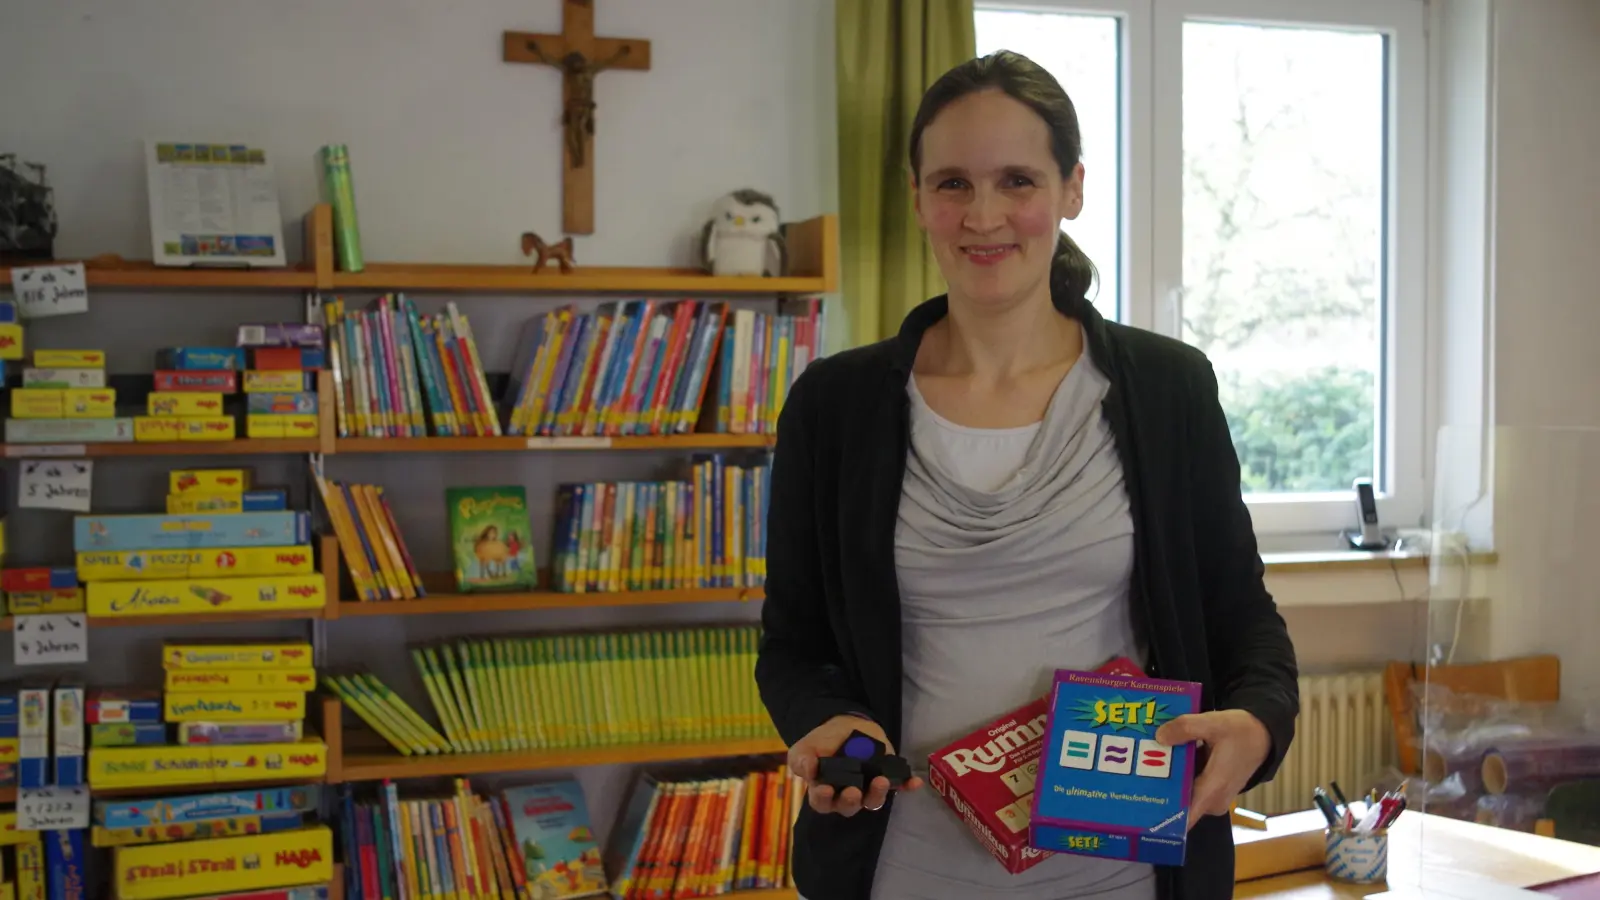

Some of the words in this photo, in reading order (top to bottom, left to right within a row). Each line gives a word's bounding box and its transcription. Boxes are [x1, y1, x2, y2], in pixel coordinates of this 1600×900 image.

[28, 483, 38, 497] 5
[45, 483, 89, 499] Jahren
[39, 621, 54, 632] ab
[36, 640, 80, 655] Jahren
[1069, 673, 1127, 688] Ravensburger
[1130, 680, 1185, 693] Kartenspiele
[1094, 700, 1156, 725] SET!
[988, 720, 1017, 737] Original
[1009, 774, 1019, 783] 7
[1054, 784, 1065, 793] Die
[1066, 786, 1107, 800] ultimative
[1149, 810, 1185, 833] Ravensburger
[1068, 835, 1099, 849] SET!
[1141, 836, 1182, 846] Ravensburger
[275, 847, 322, 869] HABA
